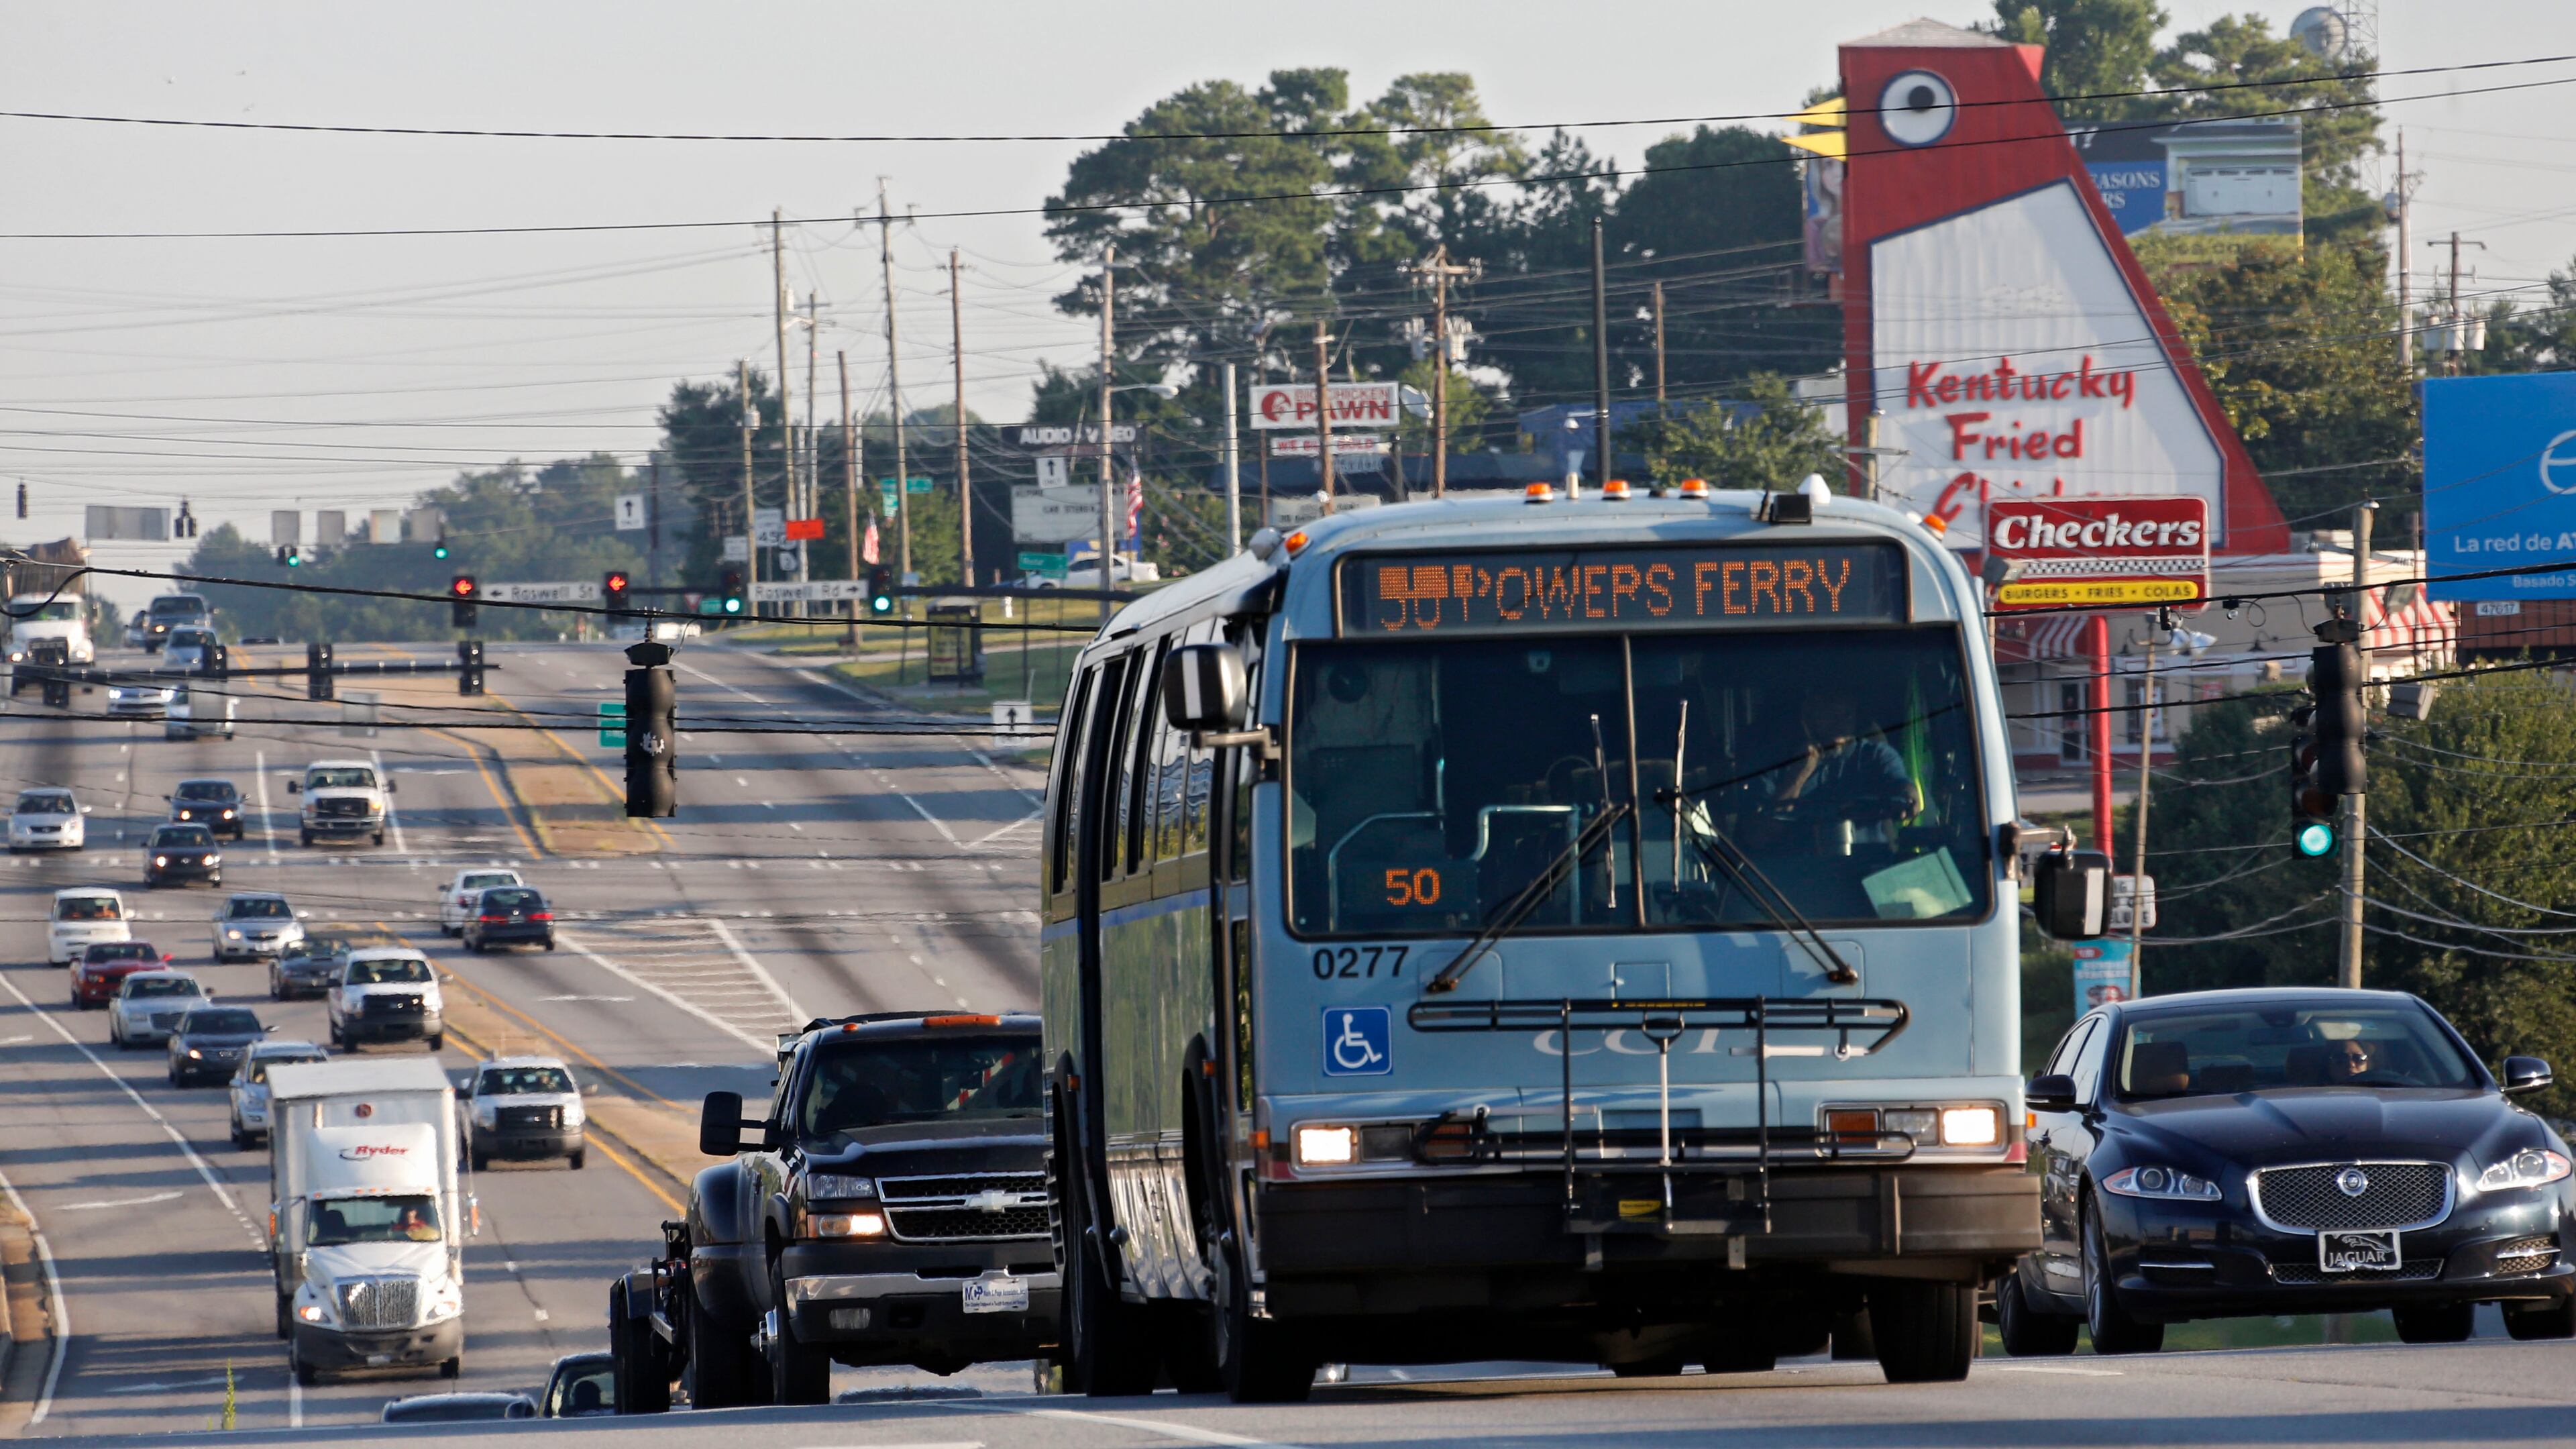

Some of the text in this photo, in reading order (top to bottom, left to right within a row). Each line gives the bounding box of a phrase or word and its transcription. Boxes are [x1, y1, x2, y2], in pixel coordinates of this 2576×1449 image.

[1907, 355, 2136, 410] Kentucky
[1329, 388, 1389, 400] HICKEN
[1020, 425, 1136, 445] AUDIO VEO
[1944, 412, 2084, 460] Fried
[1994, 513, 2201, 549] Checkers
[2455, 535, 2480, 553] La
[2485, 533, 2520, 551] red
[2526, 533, 2552, 551] de
[1695, 558, 1850, 615] FERRY
[2512, 574, 2565, 588] Basado
[511, 584, 570, 600] Roswell
[755, 584, 839, 600] Roswell Rd
[2004, 584, 2191, 600] BURGERS FRIES COLAS
[1386, 867, 1440, 905] 50
[1313, 945, 1409, 979] 0277
[354, 1144, 409, 1157] Ryder
[2328, 1251, 2386, 1267] JAGUAR
